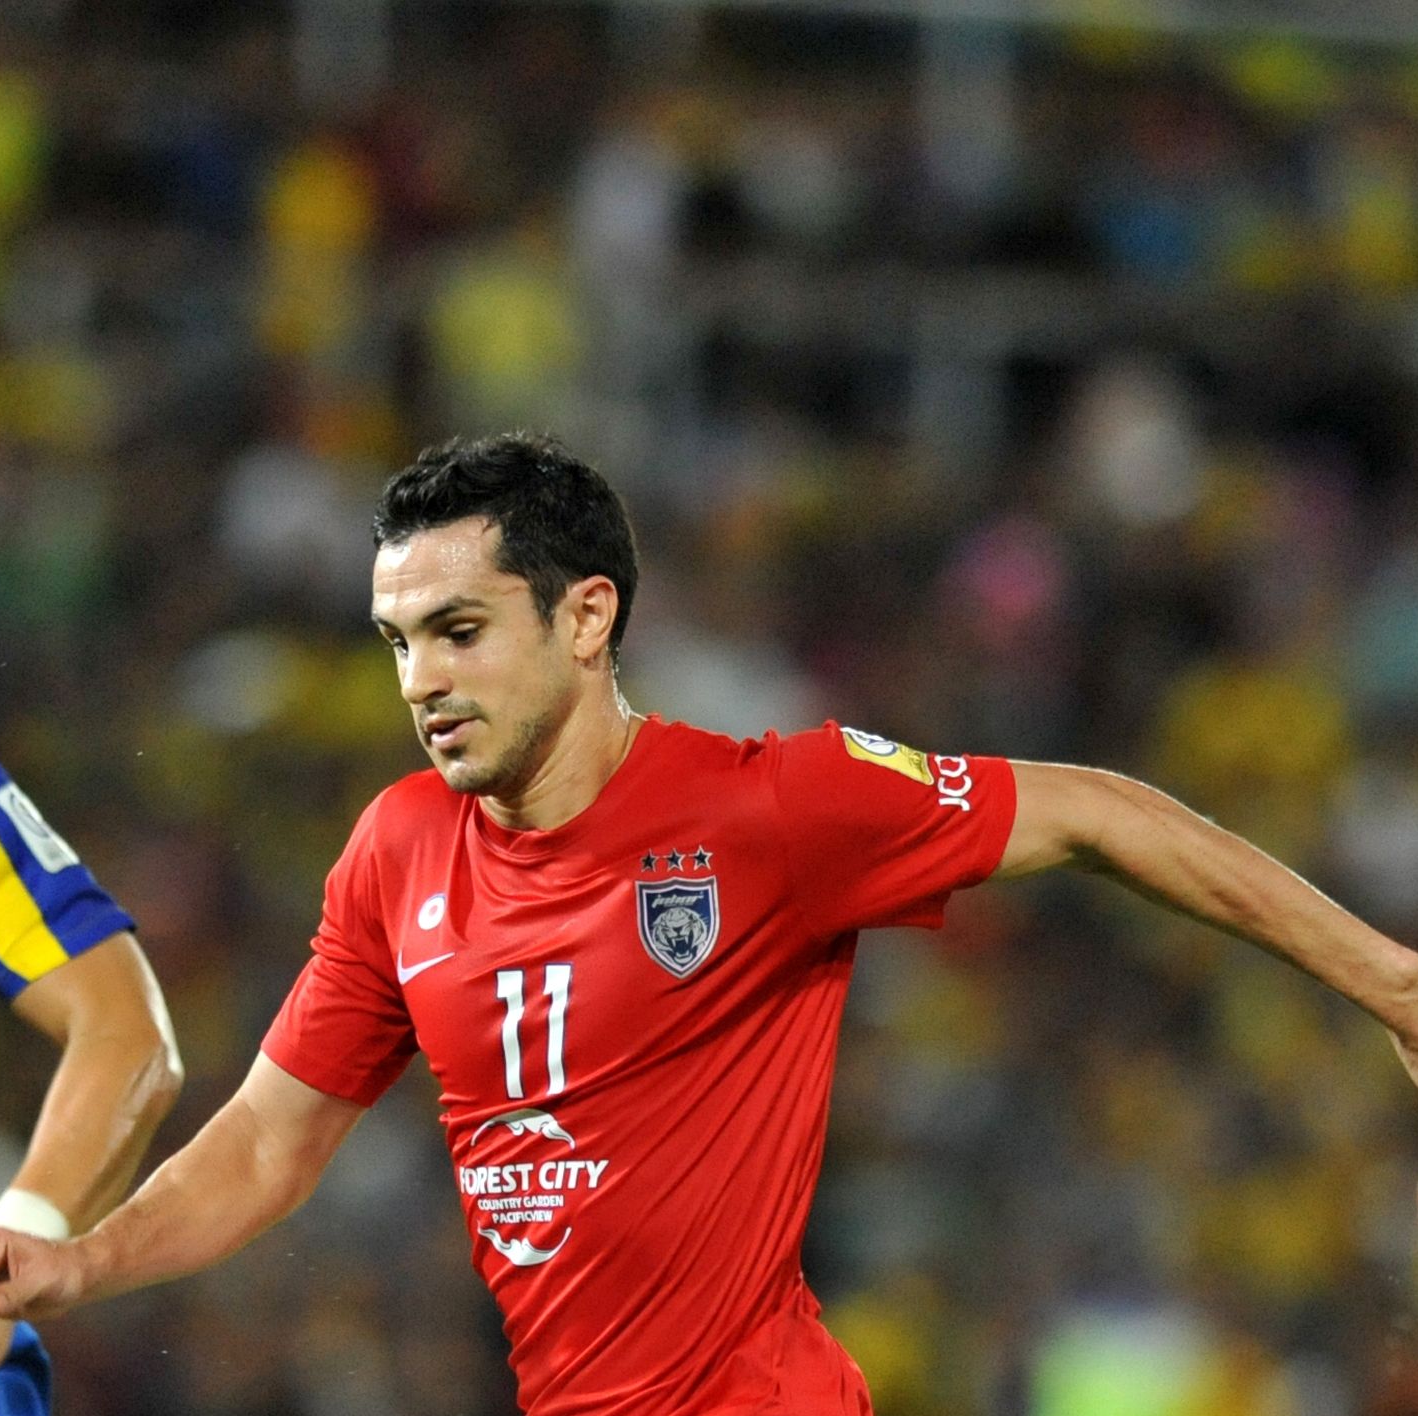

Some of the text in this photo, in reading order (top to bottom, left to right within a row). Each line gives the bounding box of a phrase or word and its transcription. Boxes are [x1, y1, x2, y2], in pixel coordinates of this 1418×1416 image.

[495, 962, 573, 1099] 11
[539, 1160, 609, 1190] CITY
[477, 1195, 564, 1210] COUNTRY GARDEN
